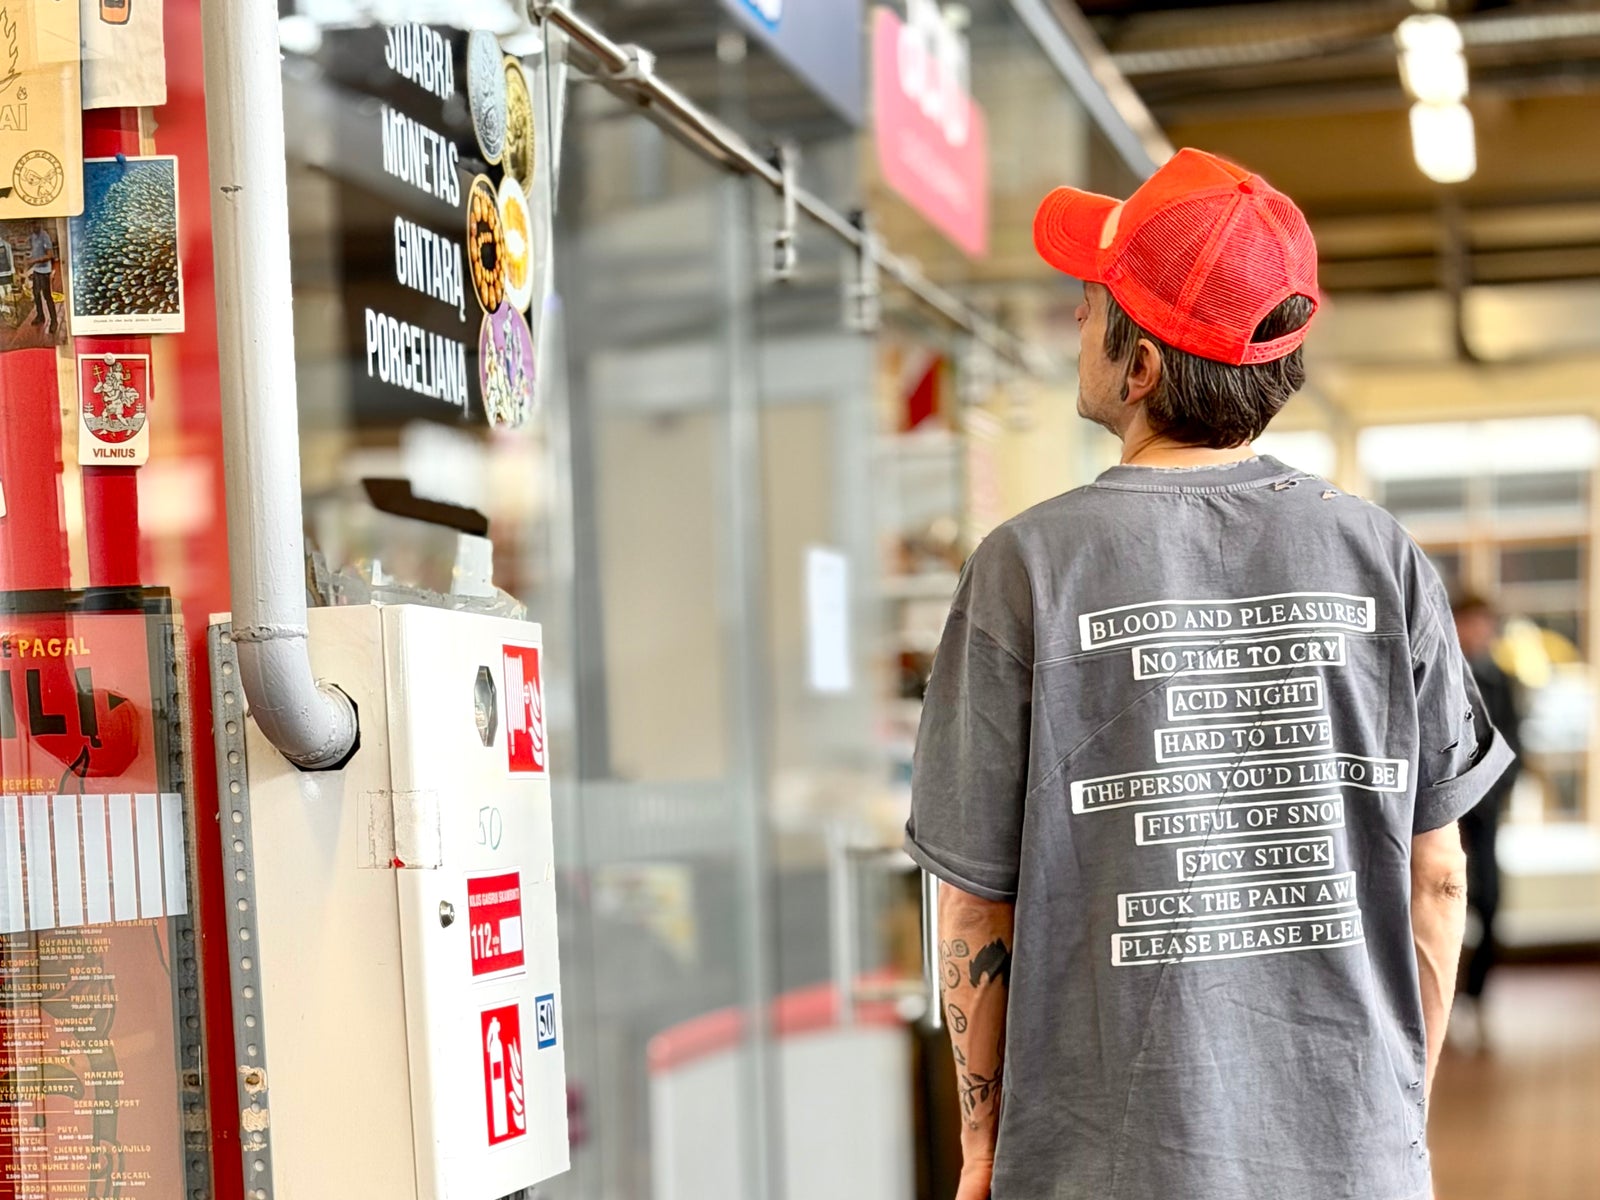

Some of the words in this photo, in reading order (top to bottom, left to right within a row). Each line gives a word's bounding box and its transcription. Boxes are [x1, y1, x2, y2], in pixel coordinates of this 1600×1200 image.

[381, 103, 460, 208] MONETAS
[394, 215, 466, 322] GINTARĄ
[365, 307, 469, 419] PORCELIANĄ
[92, 448, 136, 458] VILNIUS
[1091, 610, 1178, 642] BLOOD
[1184, 608, 1232, 630] AND
[1240, 601, 1368, 627] PLEASURES
[18, 637, 91, 658] PAGAL
[1141, 652, 1177, 674] NO
[1182, 647, 1239, 669] TIME
[1247, 645, 1281, 665] TO
[1289, 640, 1338, 663] CRY
[1174, 690, 1228, 712] ACID
[1234, 682, 1317, 708] NIGHT
[1163, 730, 1225, 755] HARD
[1231, 727, 1265, 748] TO
[1274, 721, 1331, 745] LIVE
[2, 778, 44, 791] PEPPER
[47, 777, 56, 789] X
[1083, 780, 1125, 805] THE
[1129, 771, 1213, 797] PERSON
[1215, 766, 1292, 790] YOU'D
[1337, 761, 1366, 781] TO
[1371, 765, 1396, 786] BE
[477, 806, 503, 850] 50
[1147, 811, 1240, 837] FISTFUL
[1246, 807, 1280, 828] OF
[1185, 850, 1246, 874] SPICY
[1254, 843, 1330, 868] STICK
[1126, 895, 1194, 918] FUCK
[1200, 892, 1242, 912] THE
[1247, 885, 1307, 908] PAIN
[471, 922, 493, 960] 112
[1120, 934, 1212, 958] PLEASE
[1217, 926, 1303, 951] PLEASE
[539, 1002, 554, 1038] 50
[60, 1039, 86, 1047] BLACK
[88, 1039, 114, 1047] COBRA
[84, 1070, 124, 1079] MANZANO
[114, 1099, 140, 1107] SPORT
[53, 1145, 83, 1154] CHERRY
[111, 1144, 151, 1153] GUAJILLO
[87, 1162, 101, 1170] JIM
[111, 1172, 151, 1180] CASCABEL
